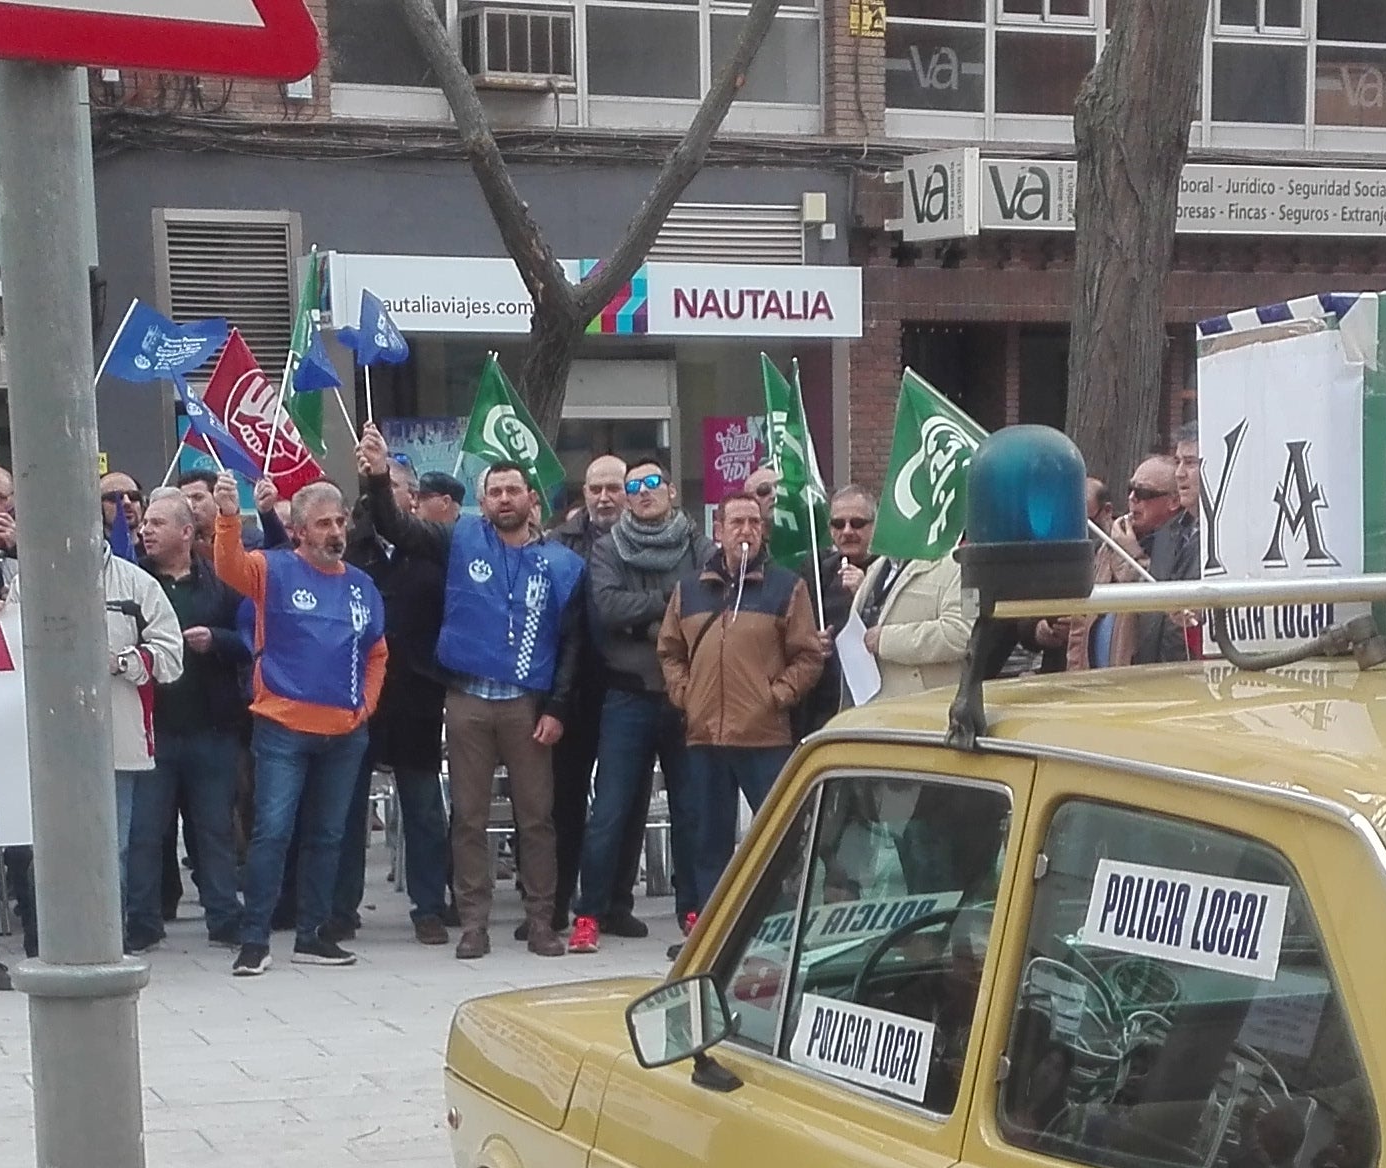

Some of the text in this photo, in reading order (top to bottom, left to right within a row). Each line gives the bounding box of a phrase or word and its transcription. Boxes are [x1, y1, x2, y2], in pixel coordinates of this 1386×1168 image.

[1179, 176, 1213, 194] boral
[1226, 176, 1275, 195] Jurídico
[1287, 179, 1350, 199] Seguridad
[1228, 203, 1267, 220] Fincas
[1279, 205, 1329, 225] Seguros
[383, 294, 534, 319] autaliaviajes.com
[674, 288, 834, 321] NAUTALIA
[1097, 872, 1269, 962] POLICIA LOCAL
[807, 1005, 921, 1086] POLICIA LOCAL
